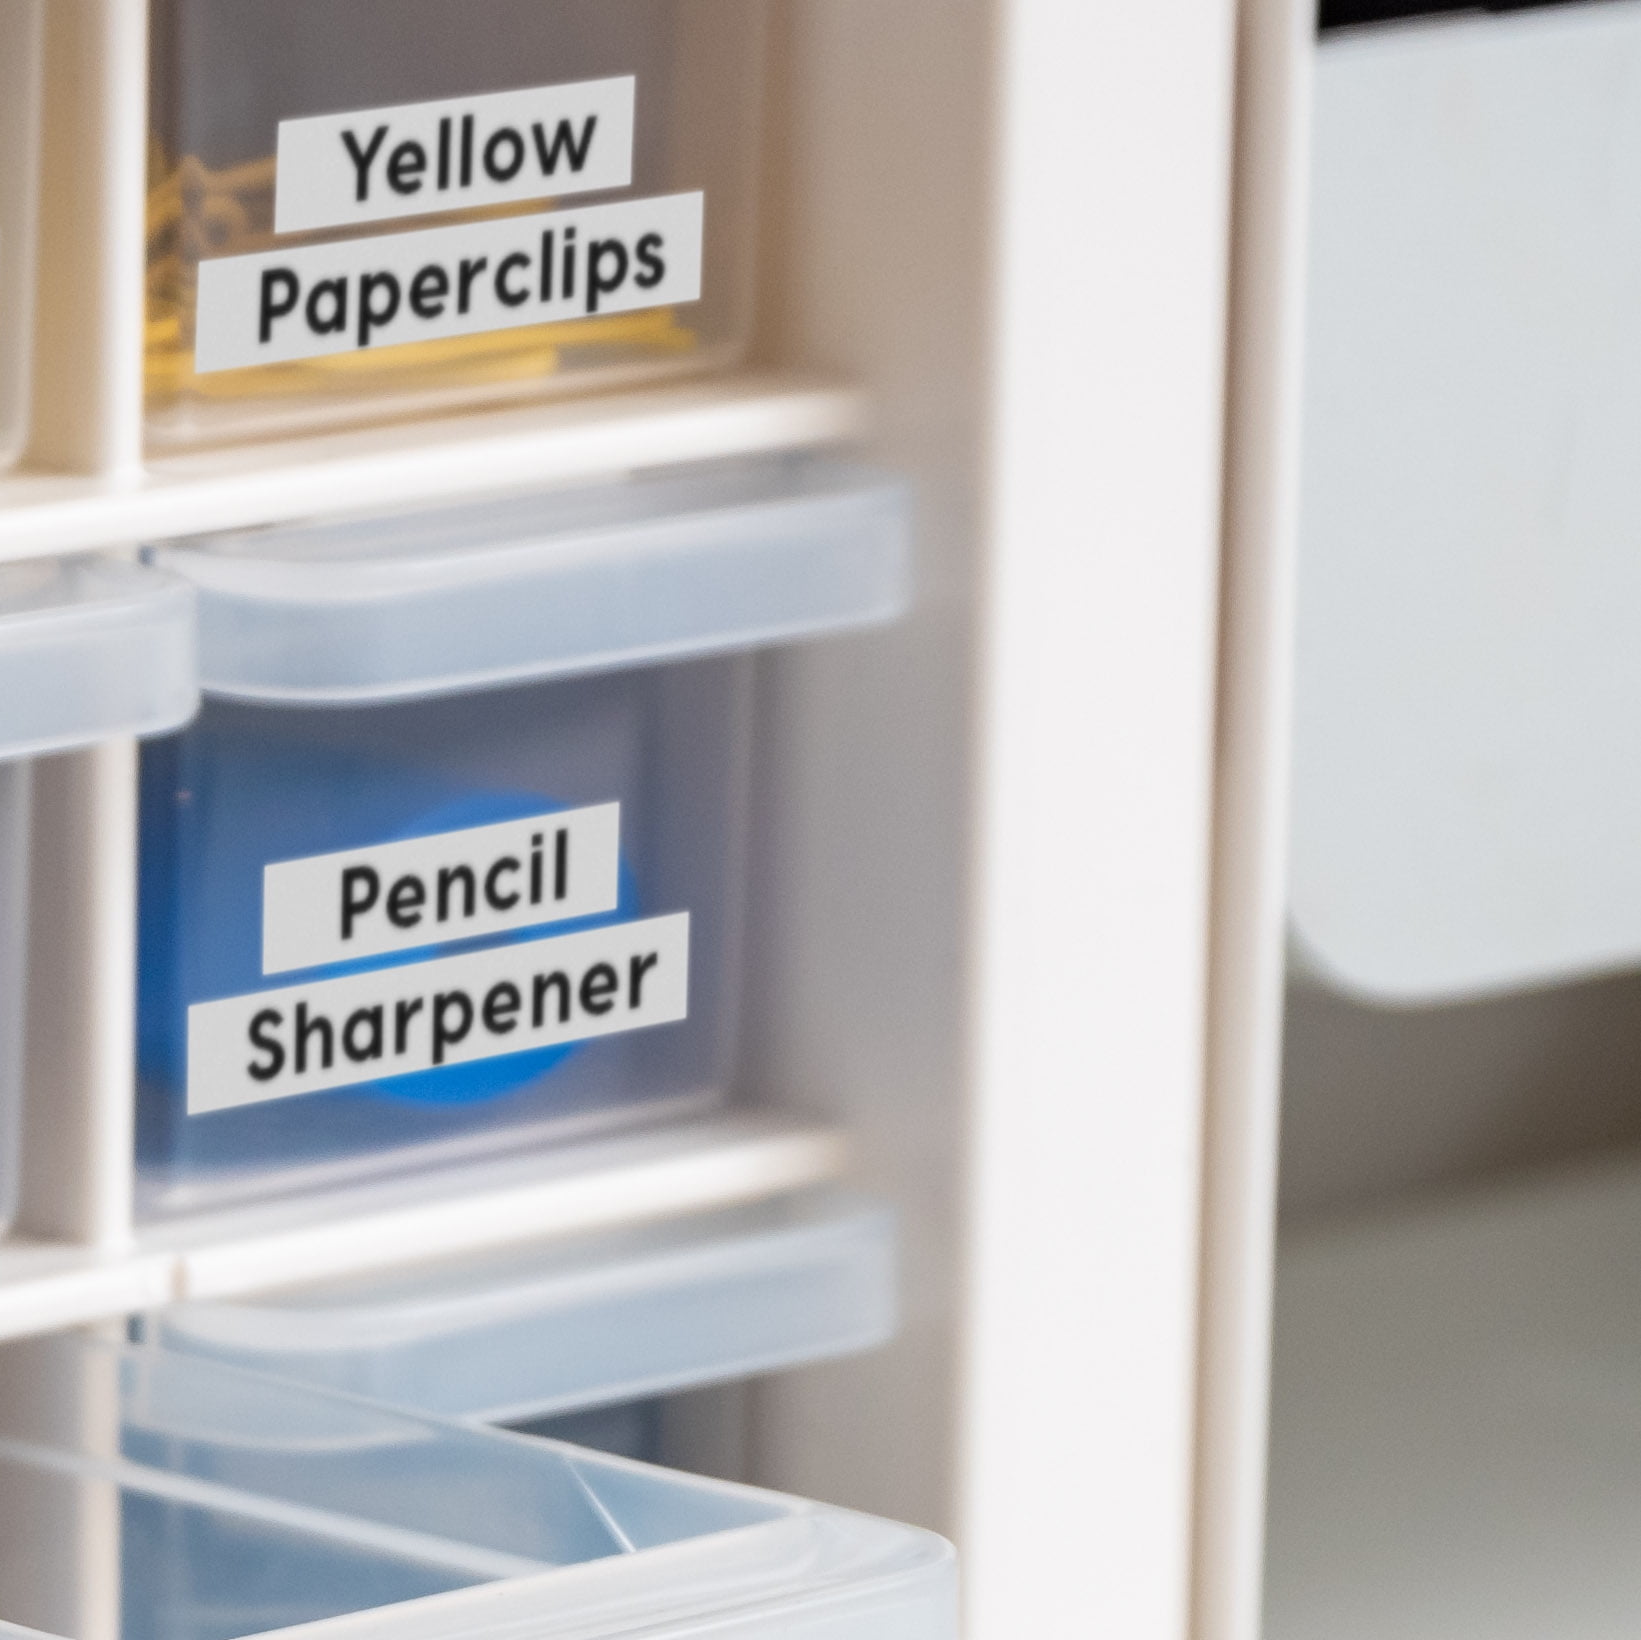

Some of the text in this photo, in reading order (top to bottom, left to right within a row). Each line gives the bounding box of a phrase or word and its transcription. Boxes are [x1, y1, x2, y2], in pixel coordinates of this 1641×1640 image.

[340, 113, 597, 202] Yellow
[258, 226, 666, 347] Paperclips
[340, 828, 568, 940] Pencil
[248, 951, 659, 1083] Sharpener
